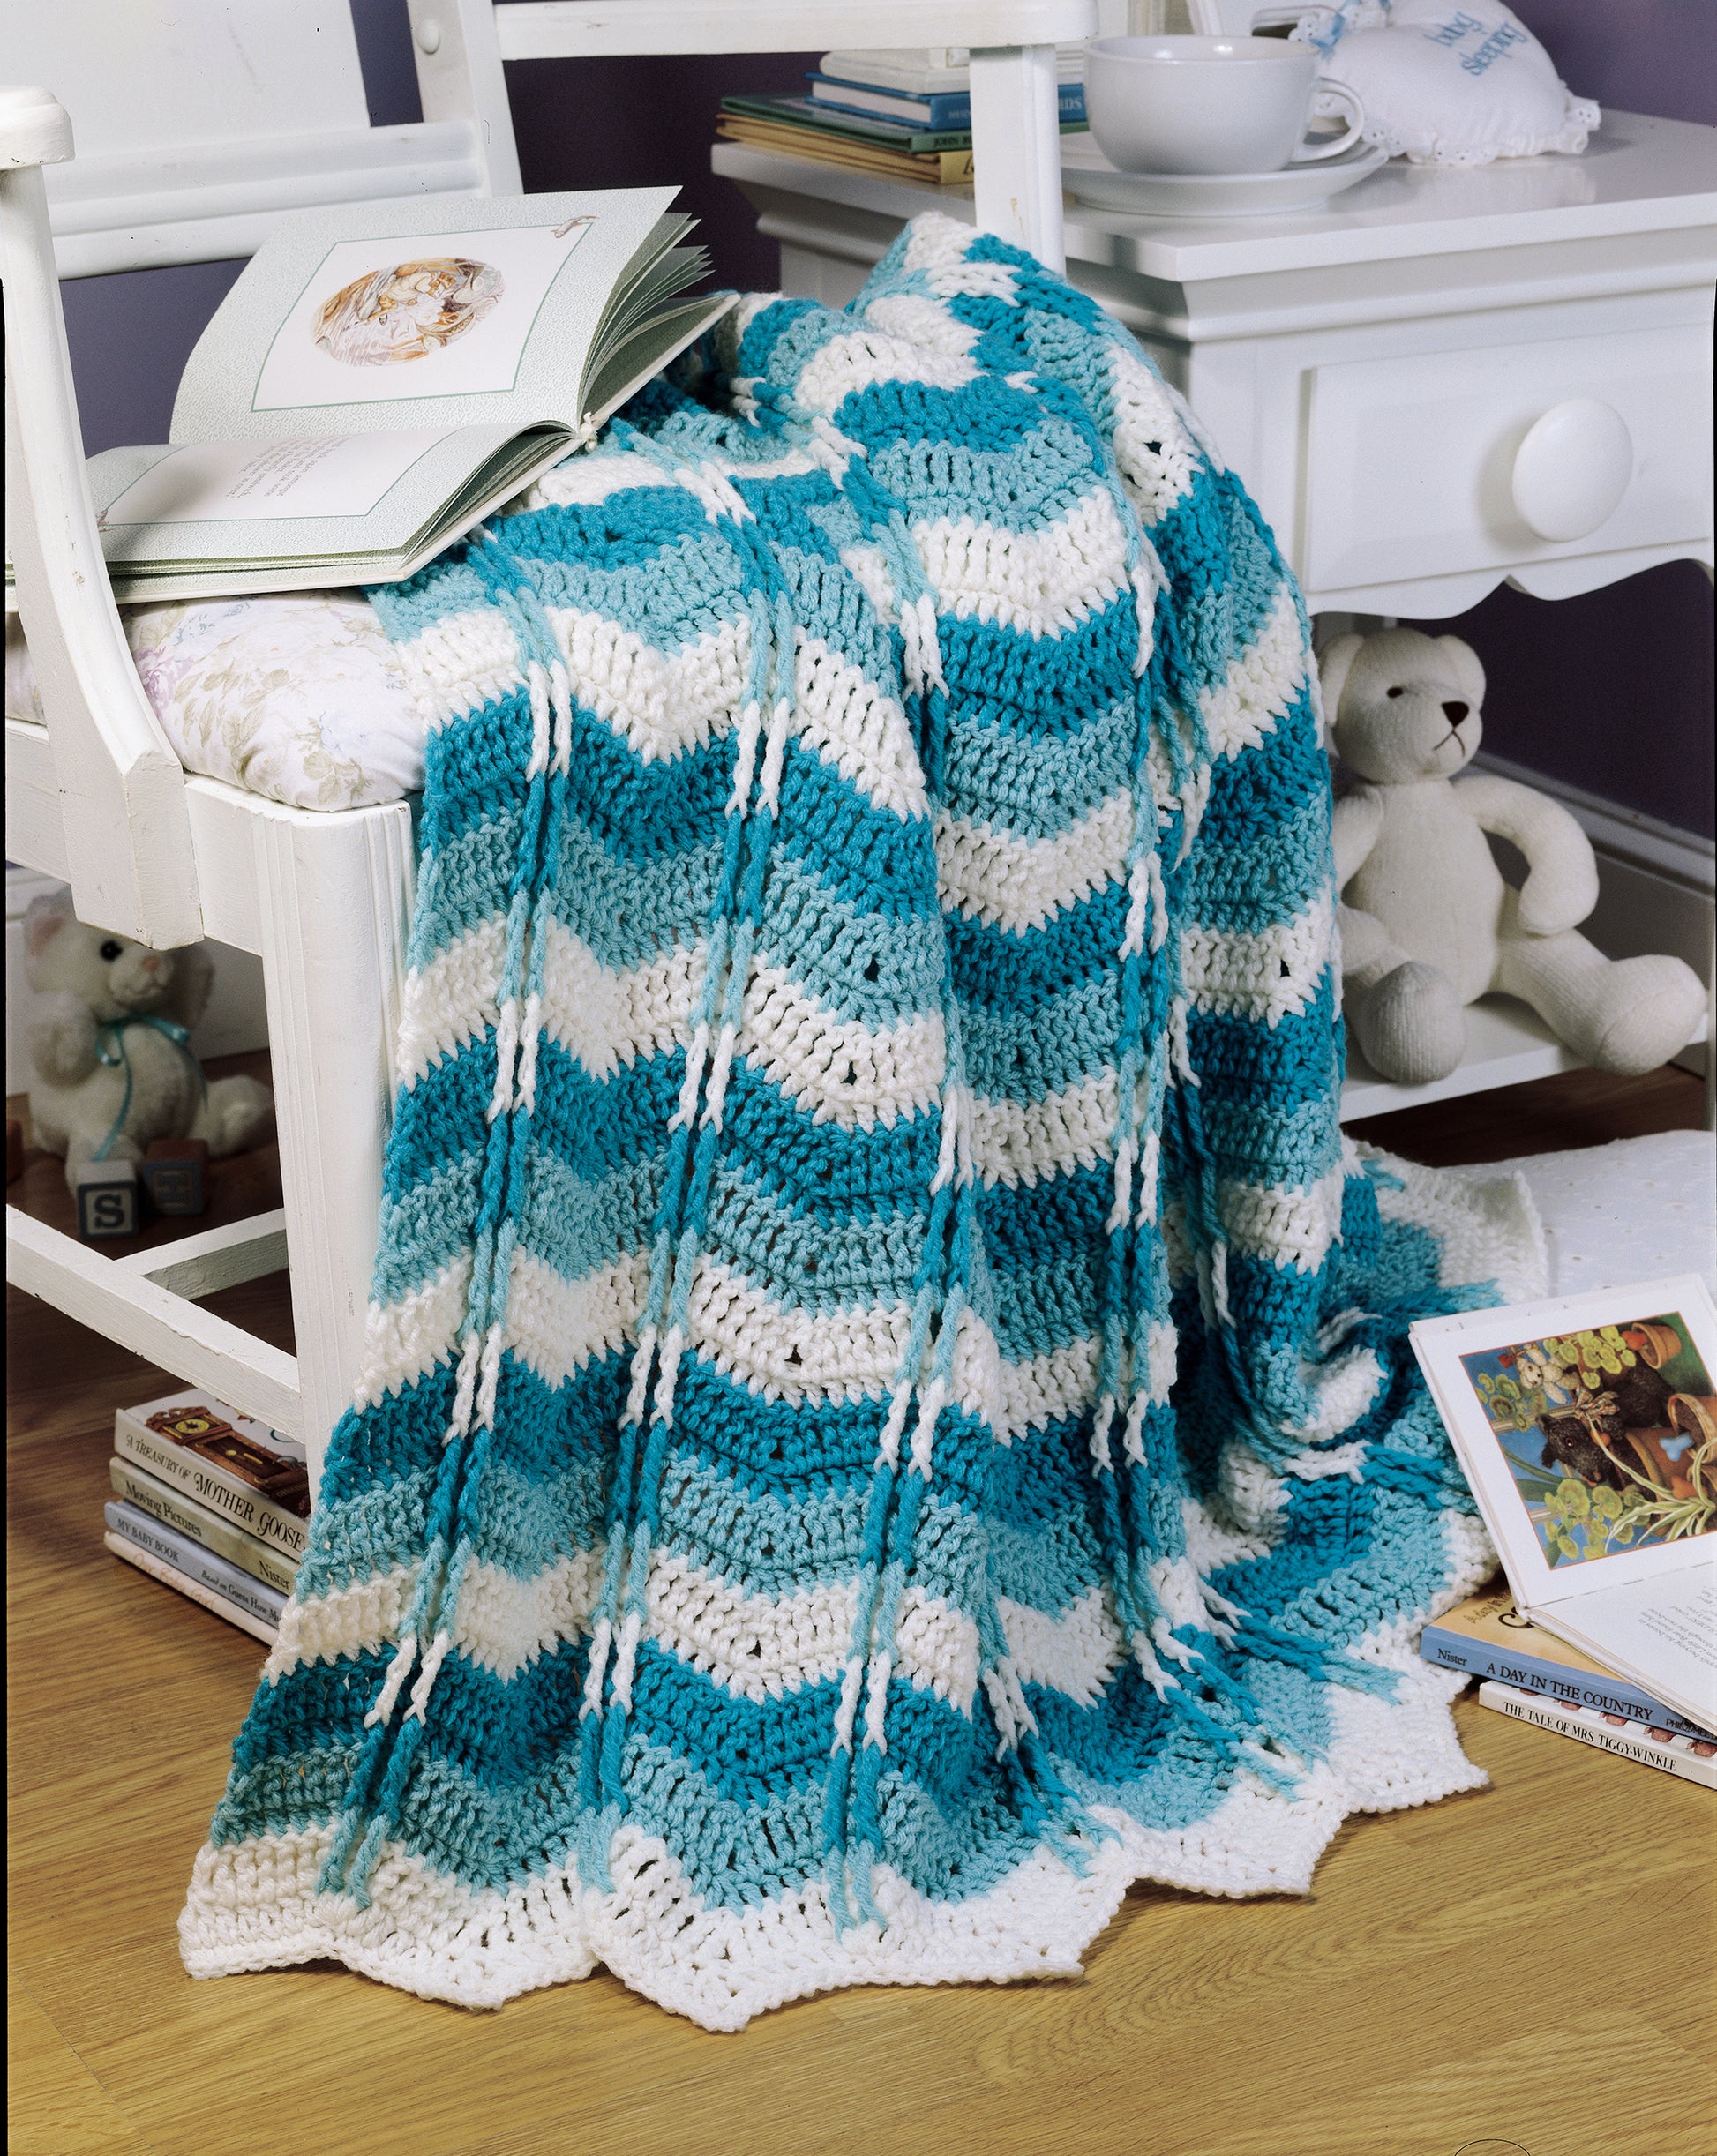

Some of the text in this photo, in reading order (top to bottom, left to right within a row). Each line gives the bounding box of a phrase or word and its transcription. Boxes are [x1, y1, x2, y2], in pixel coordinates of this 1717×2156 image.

[1422, 11, 1484, 47] baby
[94, 1194, 125, 1229] S
[126, 1434, 134, 1449] A
[136, 1438, 179, 1474] TREASURY
[178, 1466, 191, 1480] OF
[193, 1471, 254, 1523] MOTHER
[116, 1517, 131, 1532] MY
[131, 1526, 154, 1546] BABY
[155, 1539, 179, 1562] BOOK
[229, 1583, 249, 1604] Guess
[251, 1596, 267, 1614] How
[125, 1480, 290, 1590] Moving Pictures Nister
[1437, 1648, 1467, 1666] Nister
[1486, 1662, 1496, 1674] A
[1500, 1666, 1527, 1683] DAY
[1530, 1674, 1548, 1689] IN
[1550, 1680, 1581, 1700] THE
[1583, 1691, 1654, 1721] COUNTRY
[1503, 1701, 1677, 1771] THE TALE OF MRS TIGGY-WINKLE
